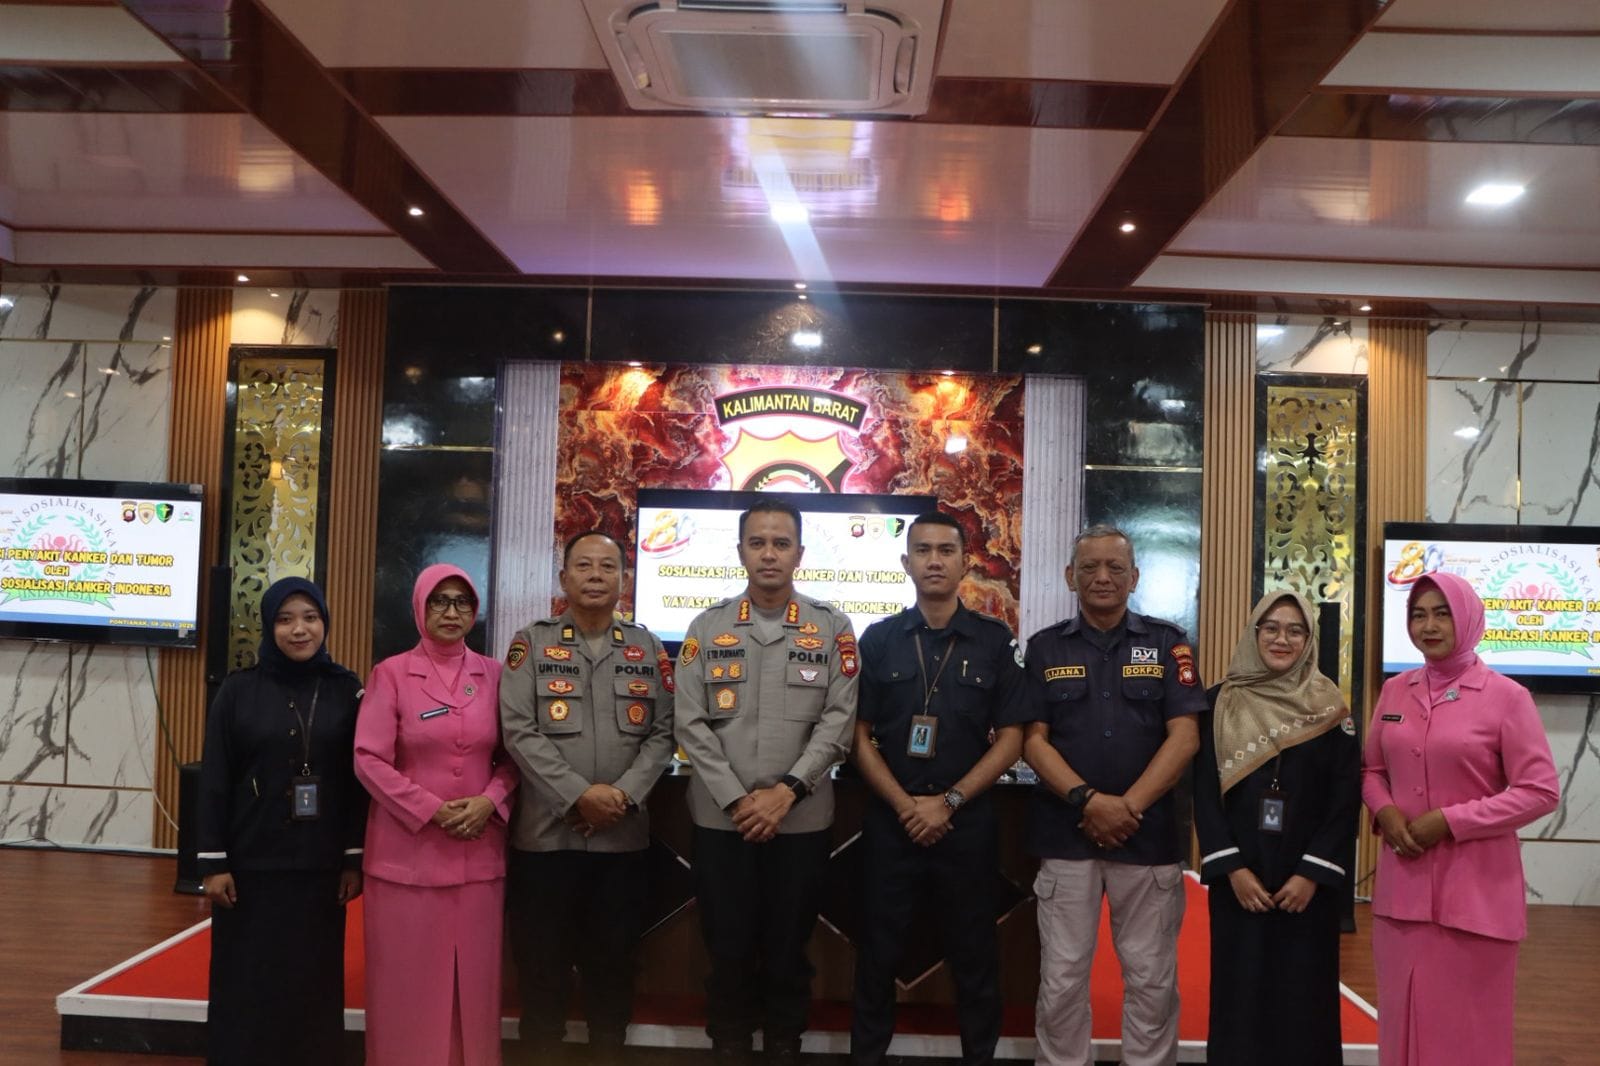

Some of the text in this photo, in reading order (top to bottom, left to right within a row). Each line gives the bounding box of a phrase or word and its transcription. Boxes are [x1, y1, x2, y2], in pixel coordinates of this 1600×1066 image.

[723, 394, 860, 423] KALIMANTAN BARAT
[22, 498, 107, 527] SOSIALISASI
[8, 549, 61, 562] PENYAKIT
[63, 551, 107, 564] KANKER
[110, 553, 133, 565] DAN
[136, 554, 174, 567] TUMOR
[1491, 545, 1581, 573] SOSIALISASI
[44, 565, 70, 577] OLEH
[658, 565, 726, 578] SOSIALISASI
[838, 571, 864, 583] DAN
[866, 570, 906, 584] TUMOR
[1, 578, 171, 597] SOSIALISASI KANKER INDONESIA
[842, 601, 904, 614] INDONESIA
[1483, 598, 1534, 611] ENYAKIT
[1536, 599, 1583, 613] KANKER
[1516, 614, 1544, 626] OLEH
[1542, 630, 1589, 644] KANKER
[788, 651, 828, 665] POLRI
[1132, 649, 1157, 659] DVI
[538, 663, 580, 676] UNTUNG
[614, 664, 654, 677] POLRI
[1125, 666, 1163, 676] DOKPOL
